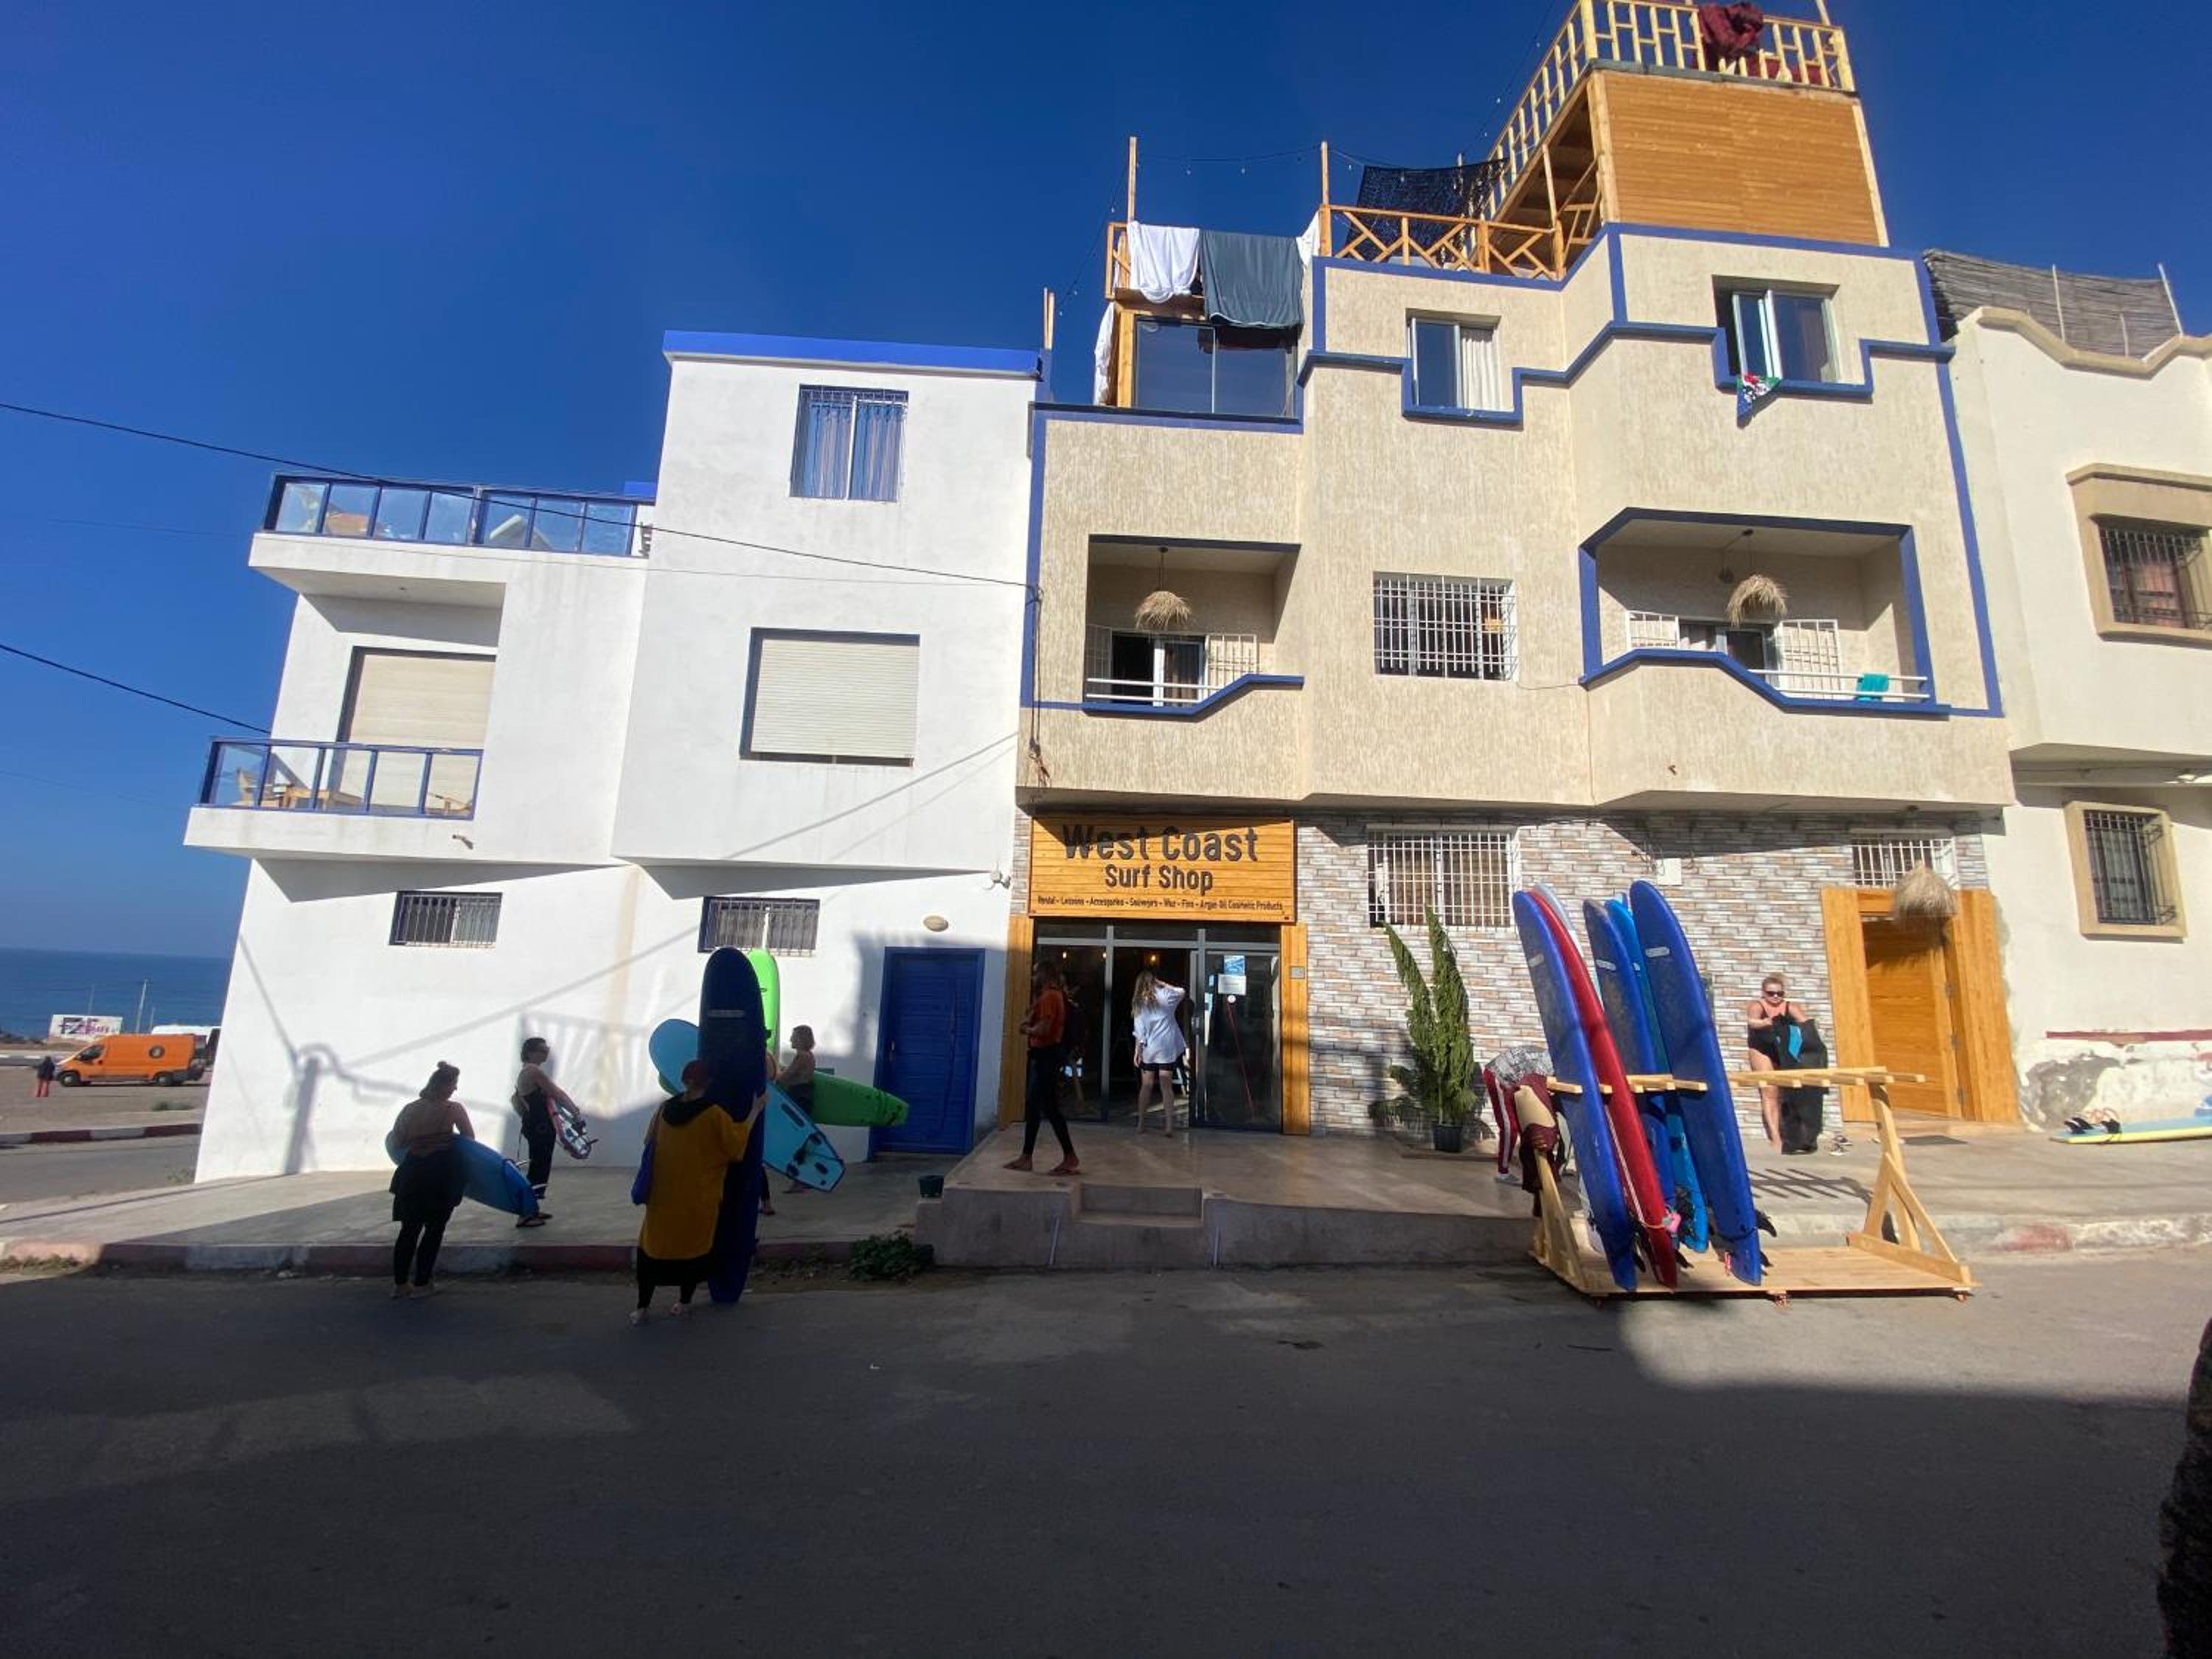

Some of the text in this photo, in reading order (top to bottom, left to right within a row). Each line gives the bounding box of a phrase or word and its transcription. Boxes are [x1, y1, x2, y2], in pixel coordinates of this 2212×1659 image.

[1062, 825, 1258, 862] West Coast
[1105, 863, 1214, 896] Surf Shop
[1256, 900, 1283, 911] Products
